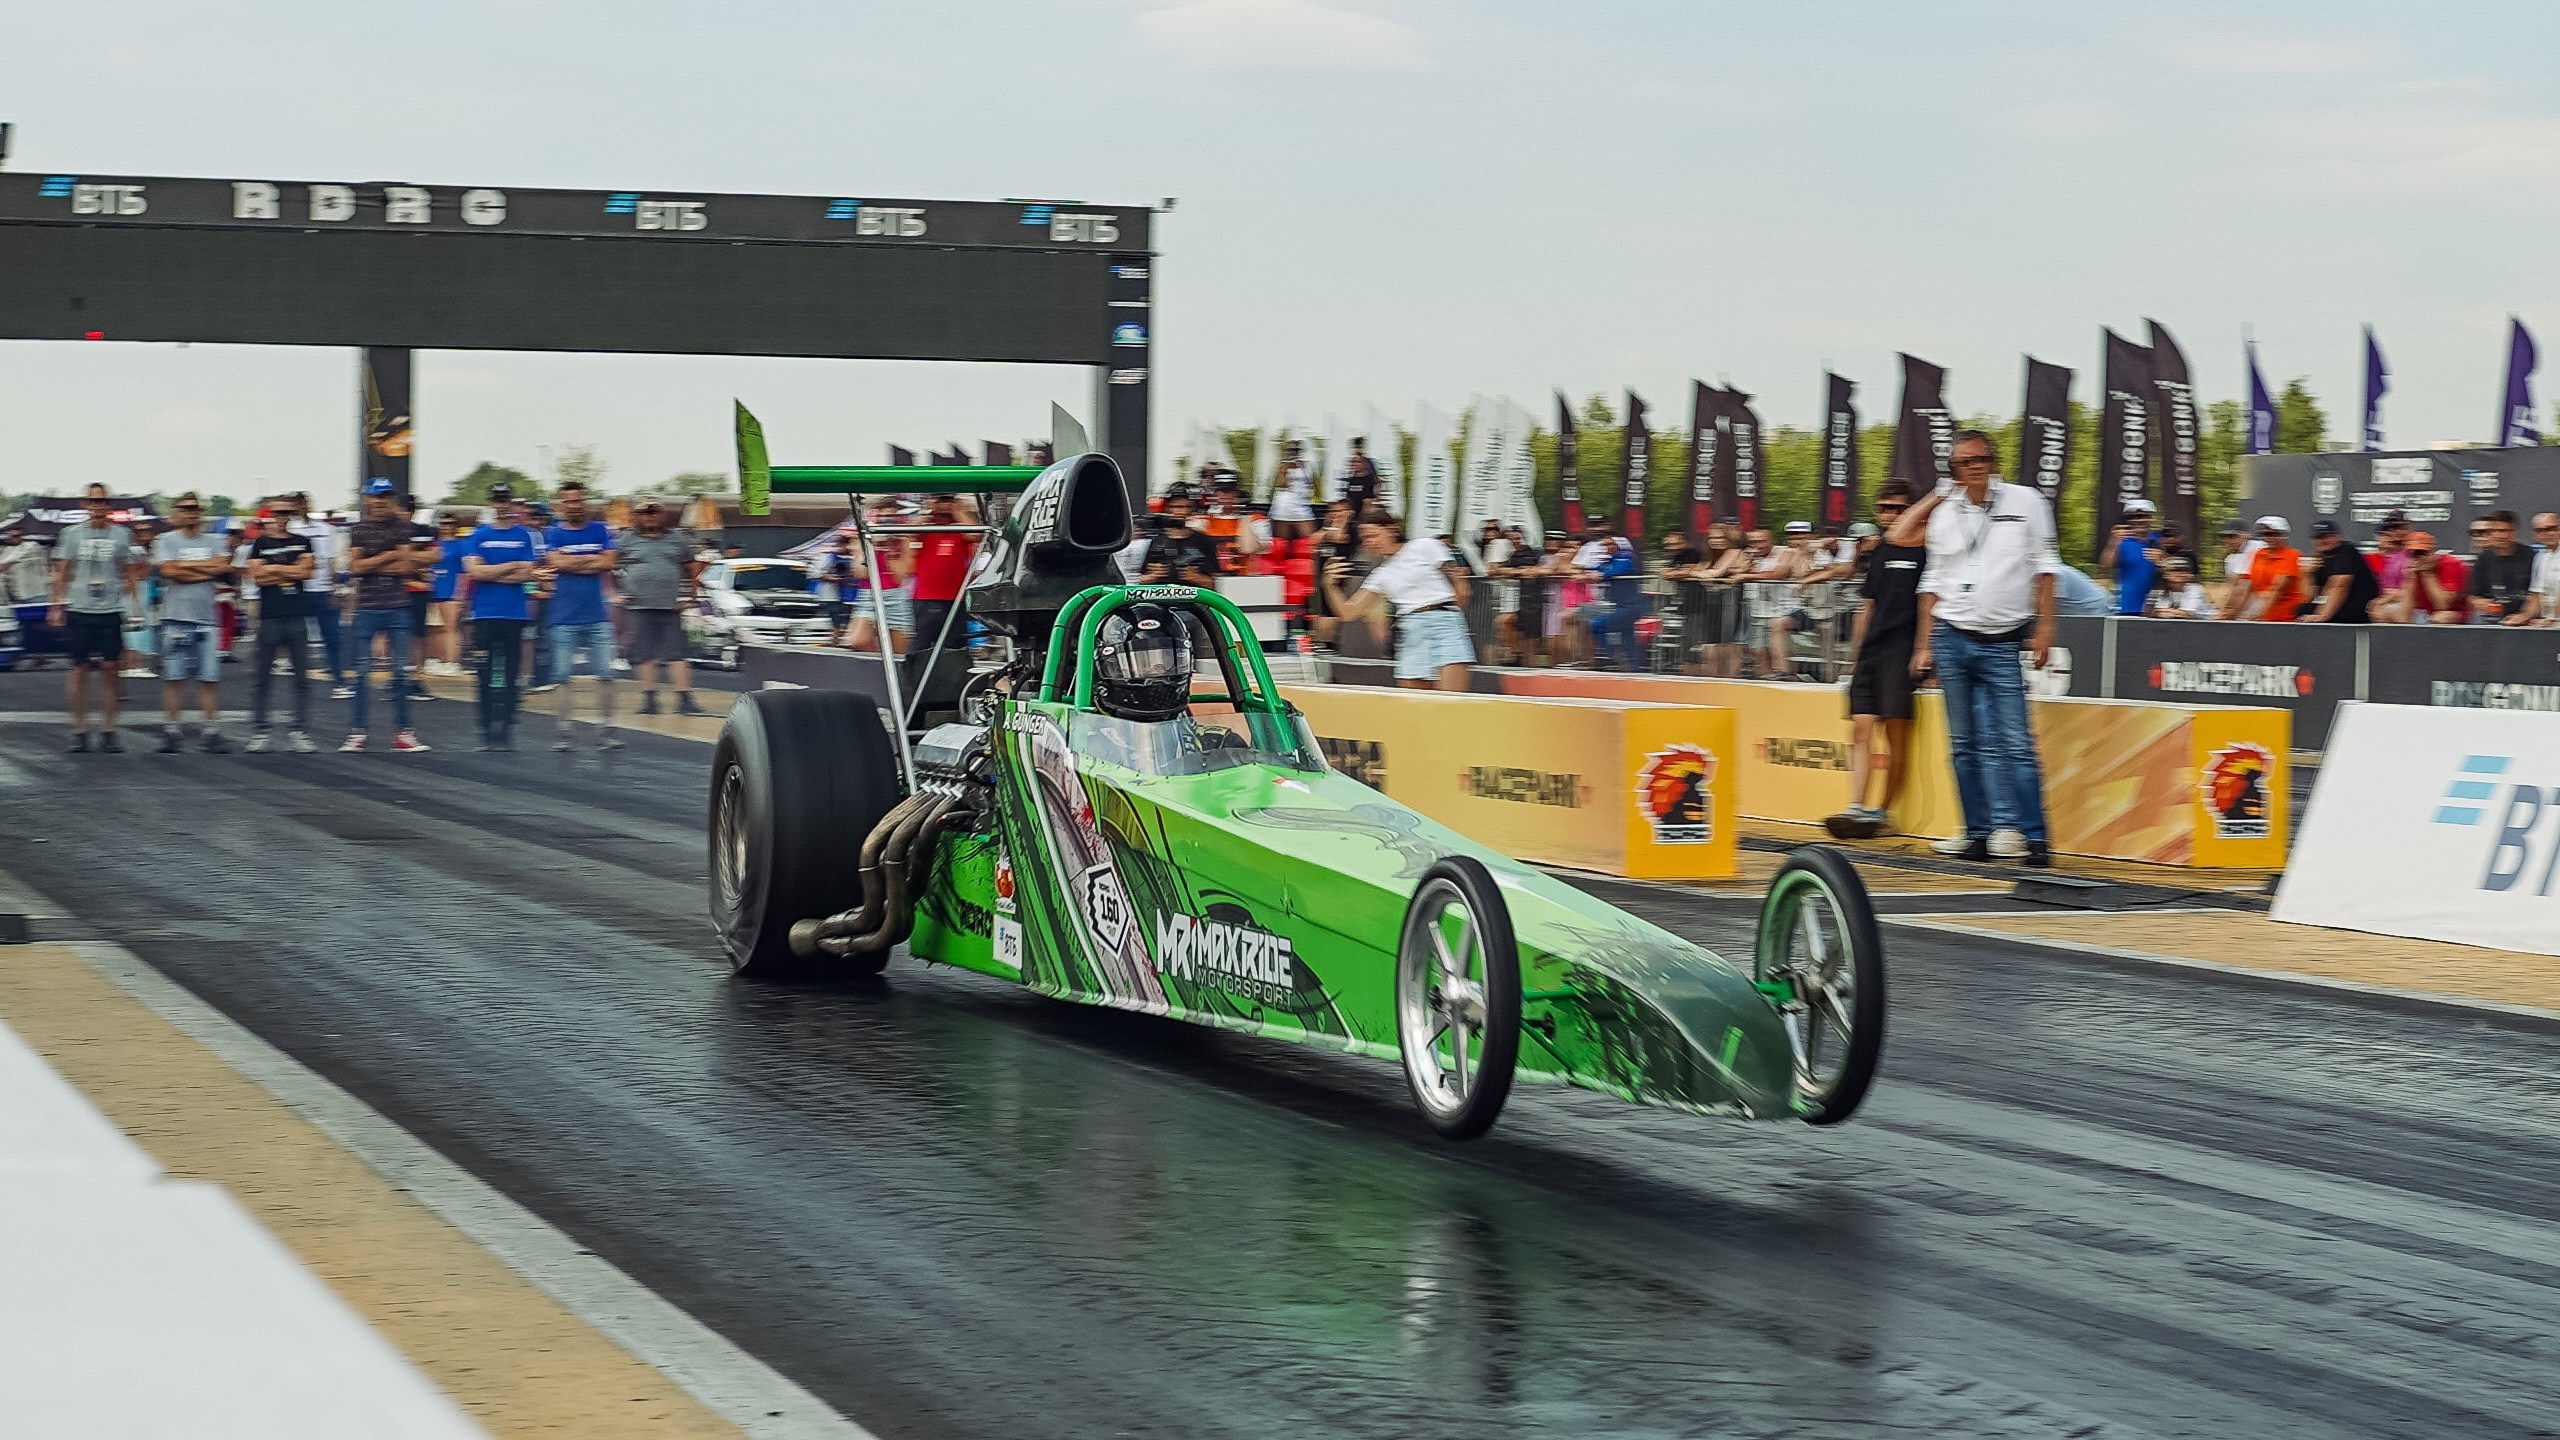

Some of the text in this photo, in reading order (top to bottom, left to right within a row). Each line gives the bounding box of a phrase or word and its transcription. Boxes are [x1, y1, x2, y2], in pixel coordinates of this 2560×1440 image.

[635, 201, 708, 231] ВТБ
[856, 207, 928, 237] ВТБ
[1050, 213, 1120, 243] ВТБ
[1101, 893, 1119, 926] 160
[1198, 966, 1293, 1007] MOTORSPORT
